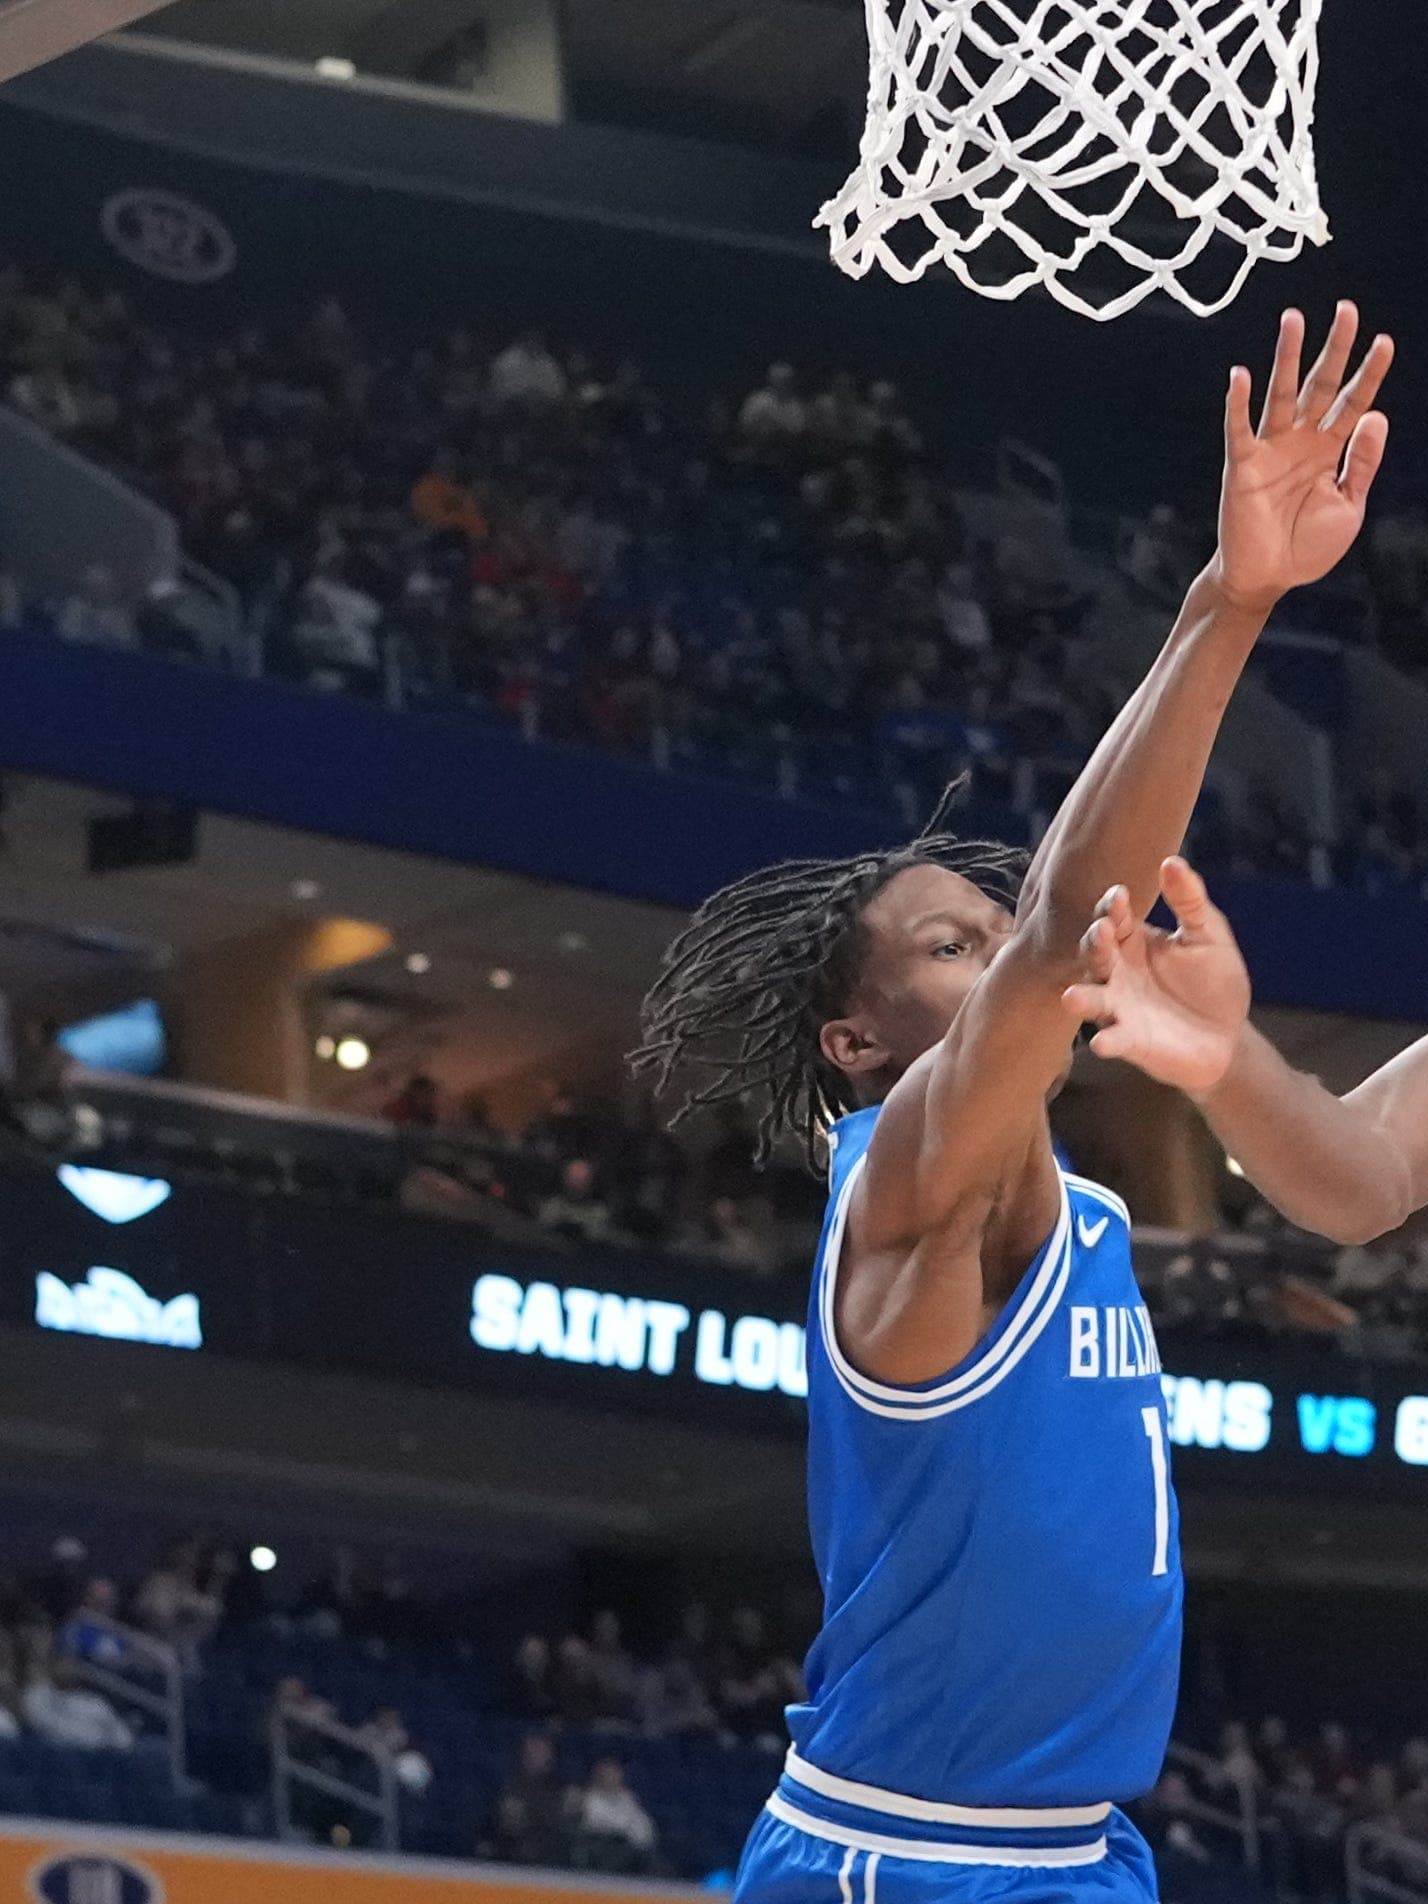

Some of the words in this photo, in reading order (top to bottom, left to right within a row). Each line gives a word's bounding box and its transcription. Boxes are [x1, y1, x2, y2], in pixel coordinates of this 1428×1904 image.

[469, 1273, 690, 1376] SAINT
[1297, 1393, 1376, 1457] VS
[1141, 1406, 1170, 1576] 1
